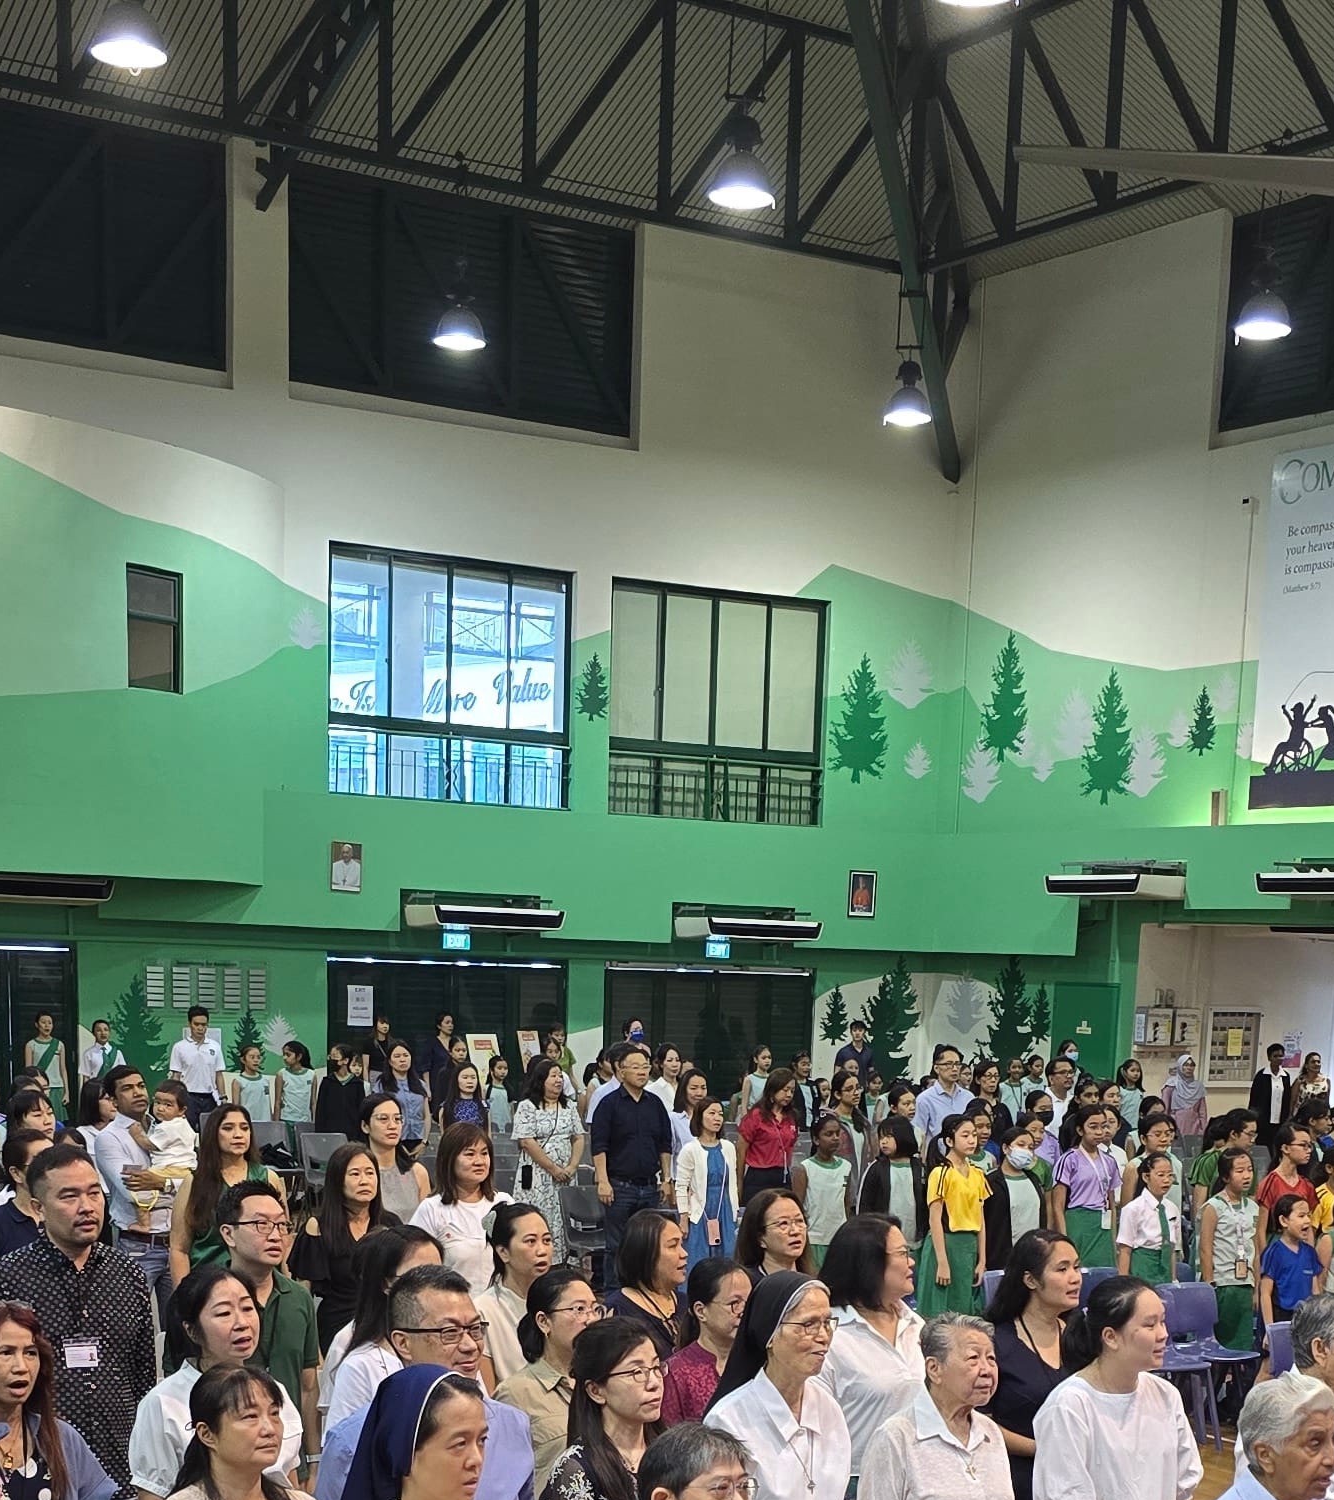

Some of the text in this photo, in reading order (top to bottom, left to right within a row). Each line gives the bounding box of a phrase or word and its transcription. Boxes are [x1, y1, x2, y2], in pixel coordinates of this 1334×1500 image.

[1287, 525, 1300, 538] Be
[1285, 543, 1307, 560] your
[1284, 563, 1292, 575] is
[423, 678, 477, 714] Mre
[446, 934, 467, 949] EXIT
